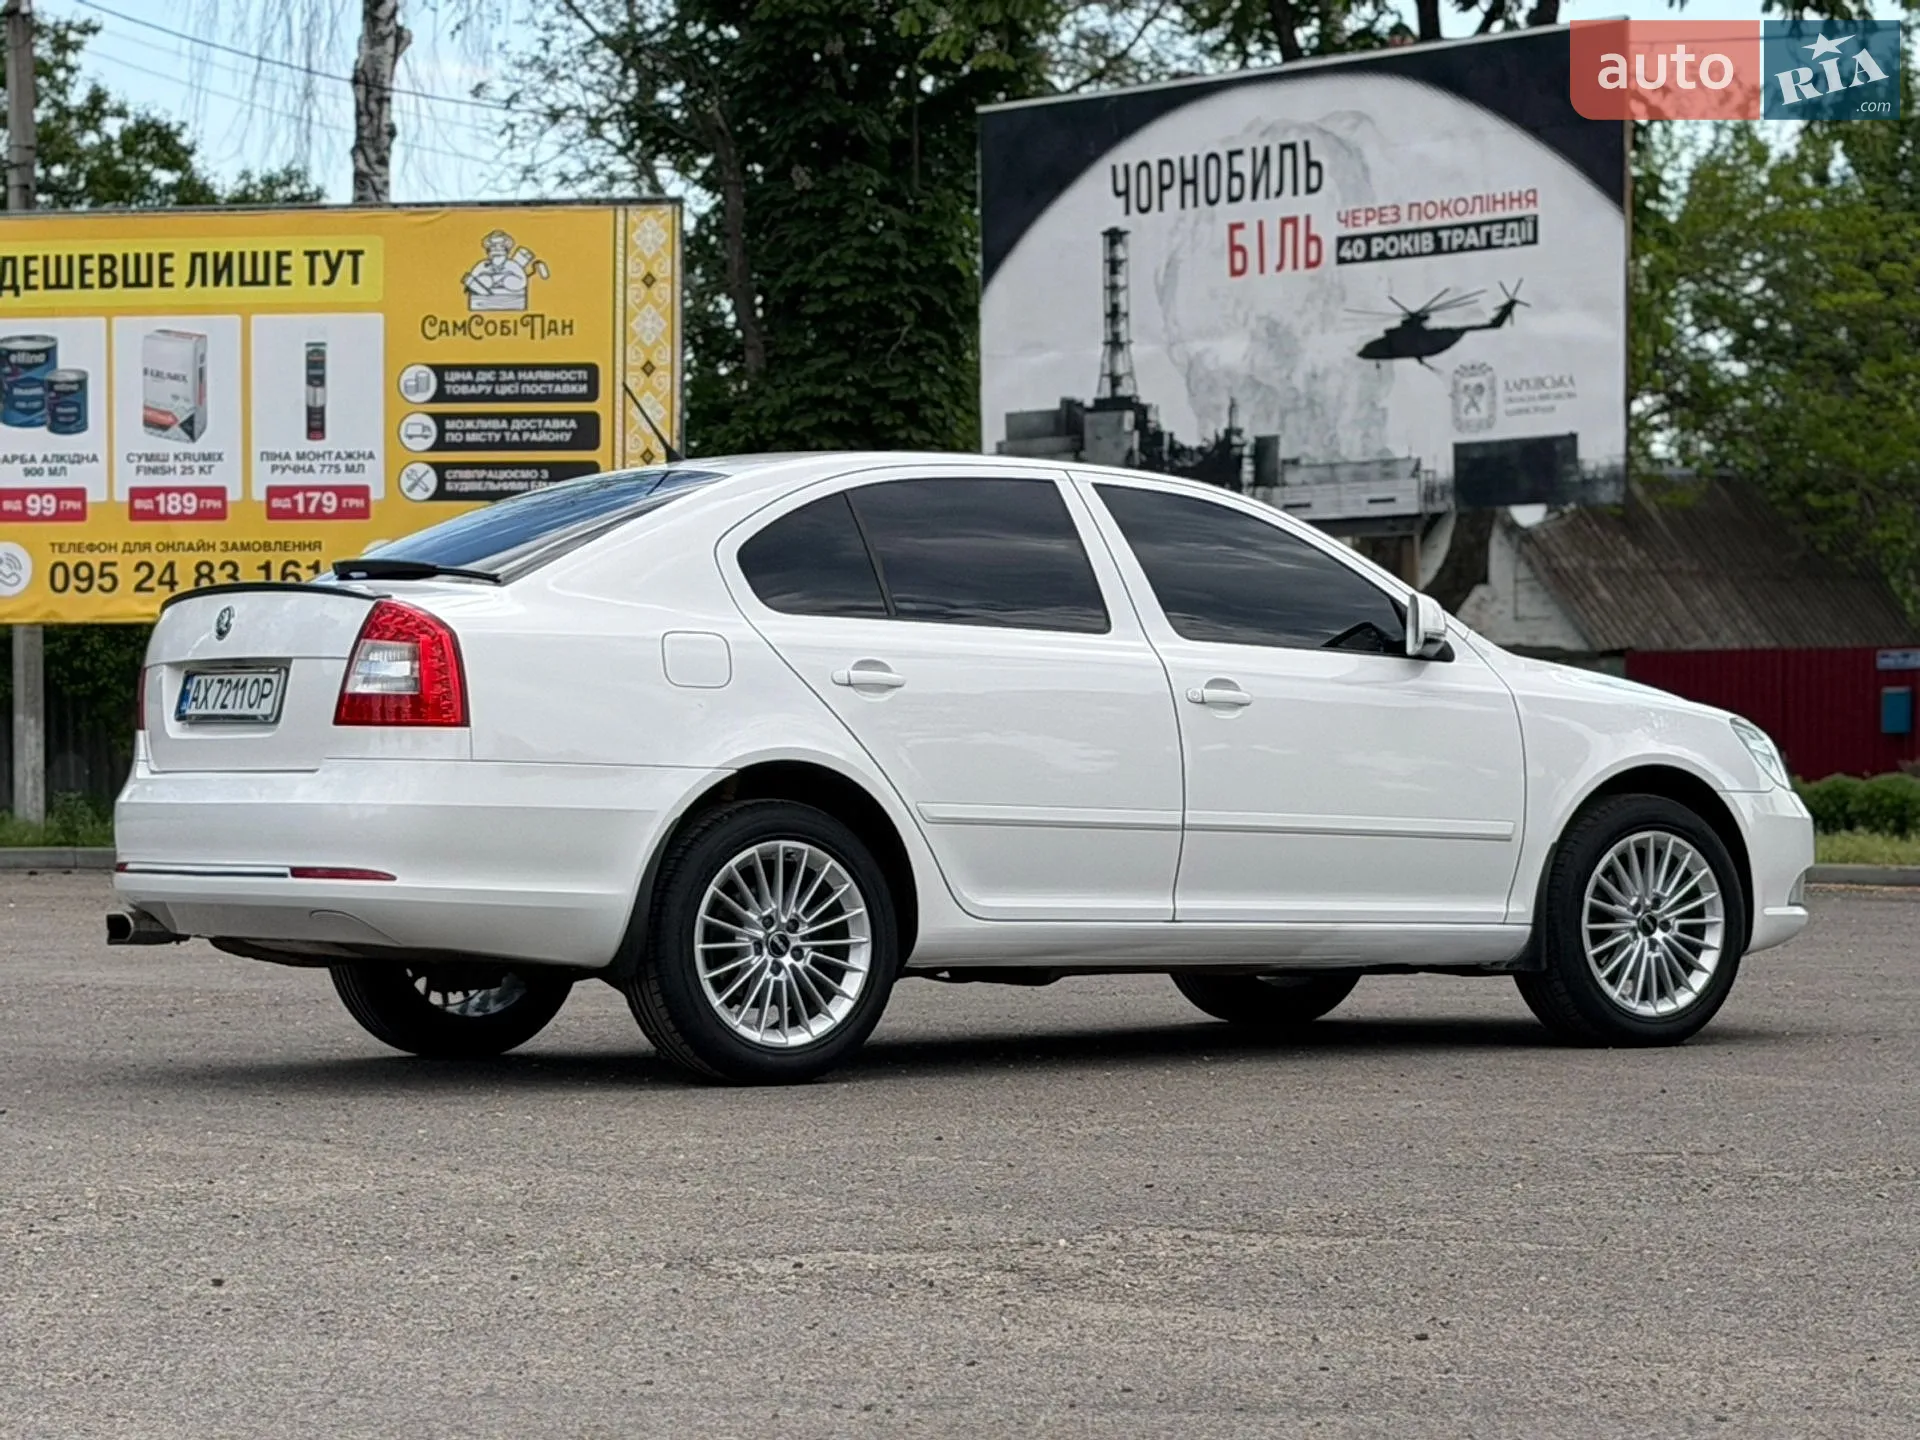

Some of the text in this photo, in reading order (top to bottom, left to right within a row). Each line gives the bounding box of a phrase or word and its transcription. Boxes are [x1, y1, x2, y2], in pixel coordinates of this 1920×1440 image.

[1112, 139, 1324, 216] ЧОРНОБИЛЬ
[1336, 188, 1538, 228] ЧЕРЕЗ ПОКОЛІННЯ
[1339, 215, 1535, 261] 40 РОКІВ ТРАГЕДІЇ
[1228, 215, 1323, 278] БІЛЬ
[0, 249, 365, 297] ДЕШЕВШЕ ЛИШЕ ТУТ
[499, 370, 515, 382] ЗА
[517, 369, 588, 382] НАЯВНОСТІ
[444, 384, 493, 395] ТОВАРУ
[521, 383, 588, 395] ПОСТАВКИ
[445, 419, 578, 431] МОЖЛИВА ДОСТАВКА
[445, 429, 572, 443] ПО МІСТУ ТА РАЙОНУ
[0, 452, 99, 465] АРБА АЛКІДНА
[126, 451, 224, 463] СУМІШ KRUMIX
[260, 450, 376, 462] ПІНА МОНТАЖНА
[23, 466, 68, 477] 900 МЛ
[136, 464, 215, 476] FINISH 25 КГ
[271, 463, 366, 475] РУЧНА 775 МЛ
[26, 493, 57, 517] 99
[155, 492, 198, 515] 189
[292, 491, 338, 514] 179
[50, 538, 322, 554] ТЕЛЕФОН ДЛЯ ОНЛАЙН ЗАМОВЛЕННЯ
[50, 560, 118, 594] 095
[134, 560, 179, 593] 24
[194, 560, 240, 588] 83
